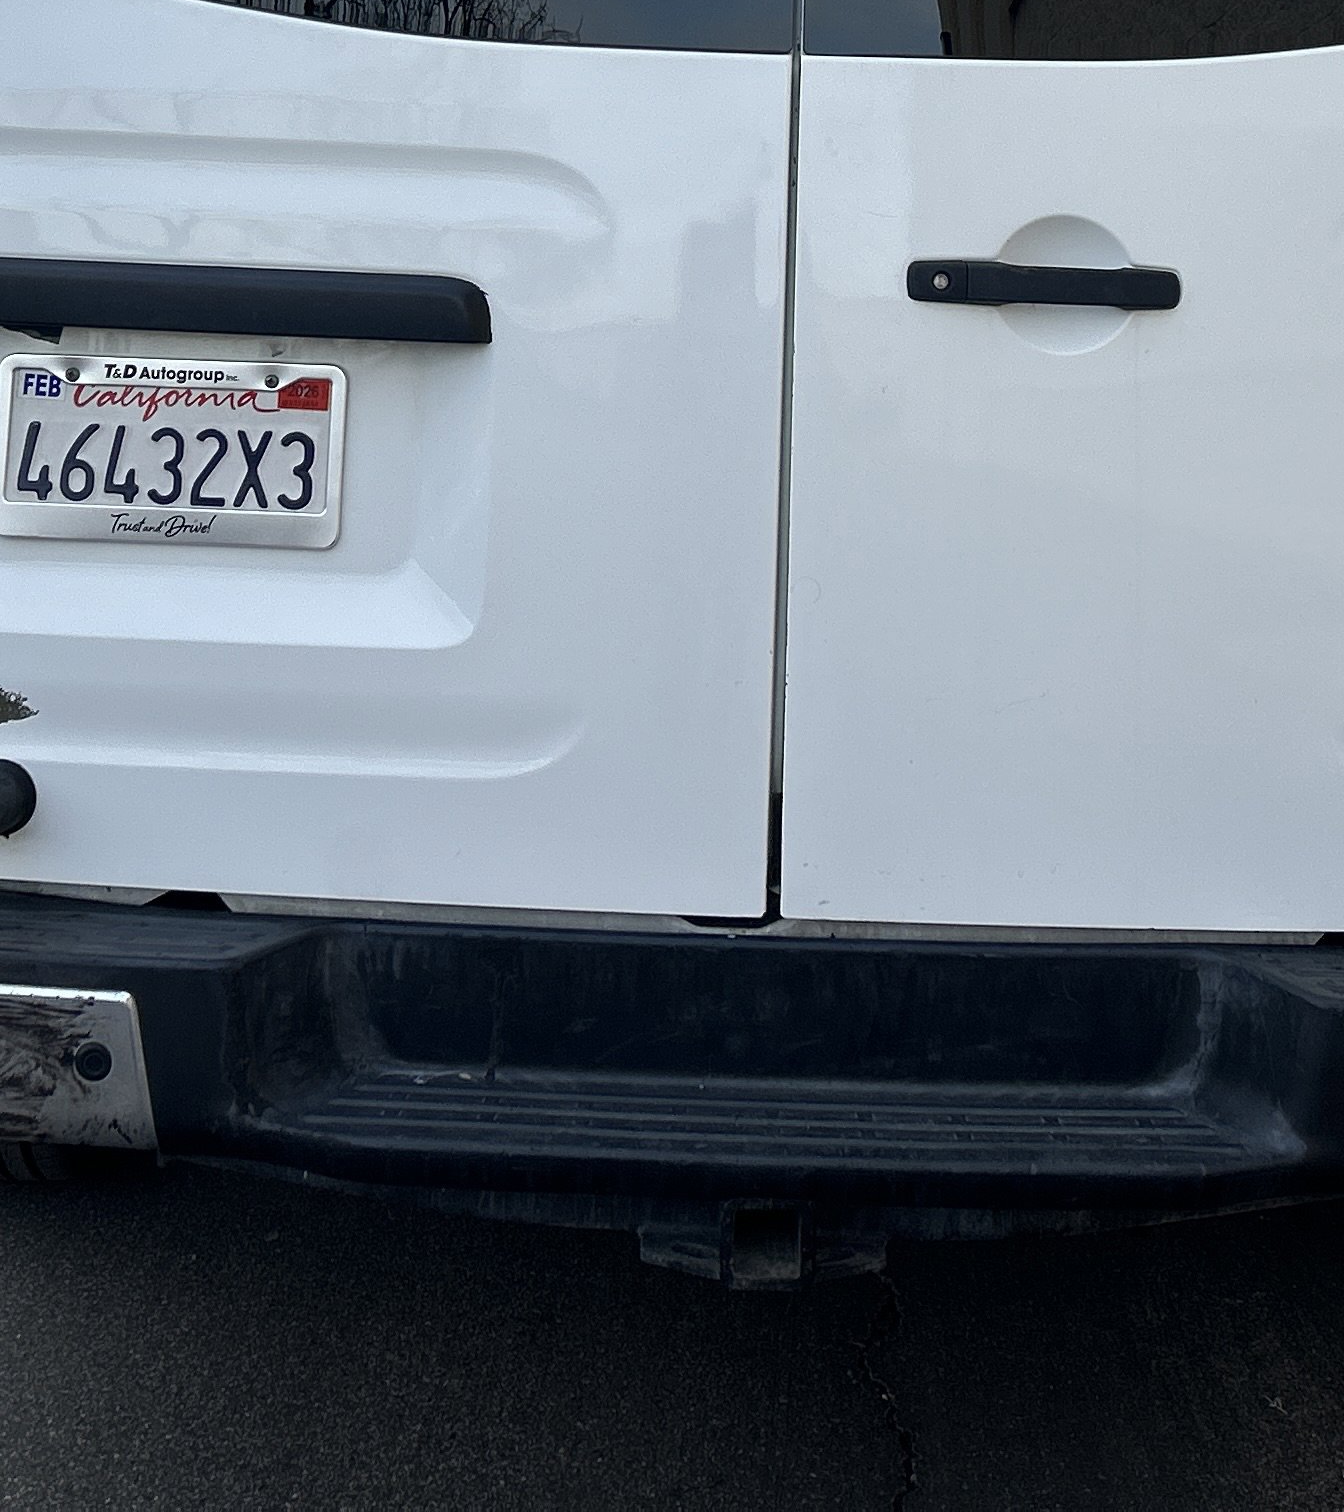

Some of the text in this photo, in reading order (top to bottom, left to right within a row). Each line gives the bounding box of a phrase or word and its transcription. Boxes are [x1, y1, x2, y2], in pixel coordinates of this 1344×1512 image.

[23, 372, 61, 398] FEB
[104, 363, 138, 379] T&D
[139, 366, 225, 384] Autogroup
[73, 383, 280, 422] California
[287, 384, 320, 398] 2026
[16, 420, 316, 511] 46432X3
[110, 513, 217, 538] Trust and Drive!
